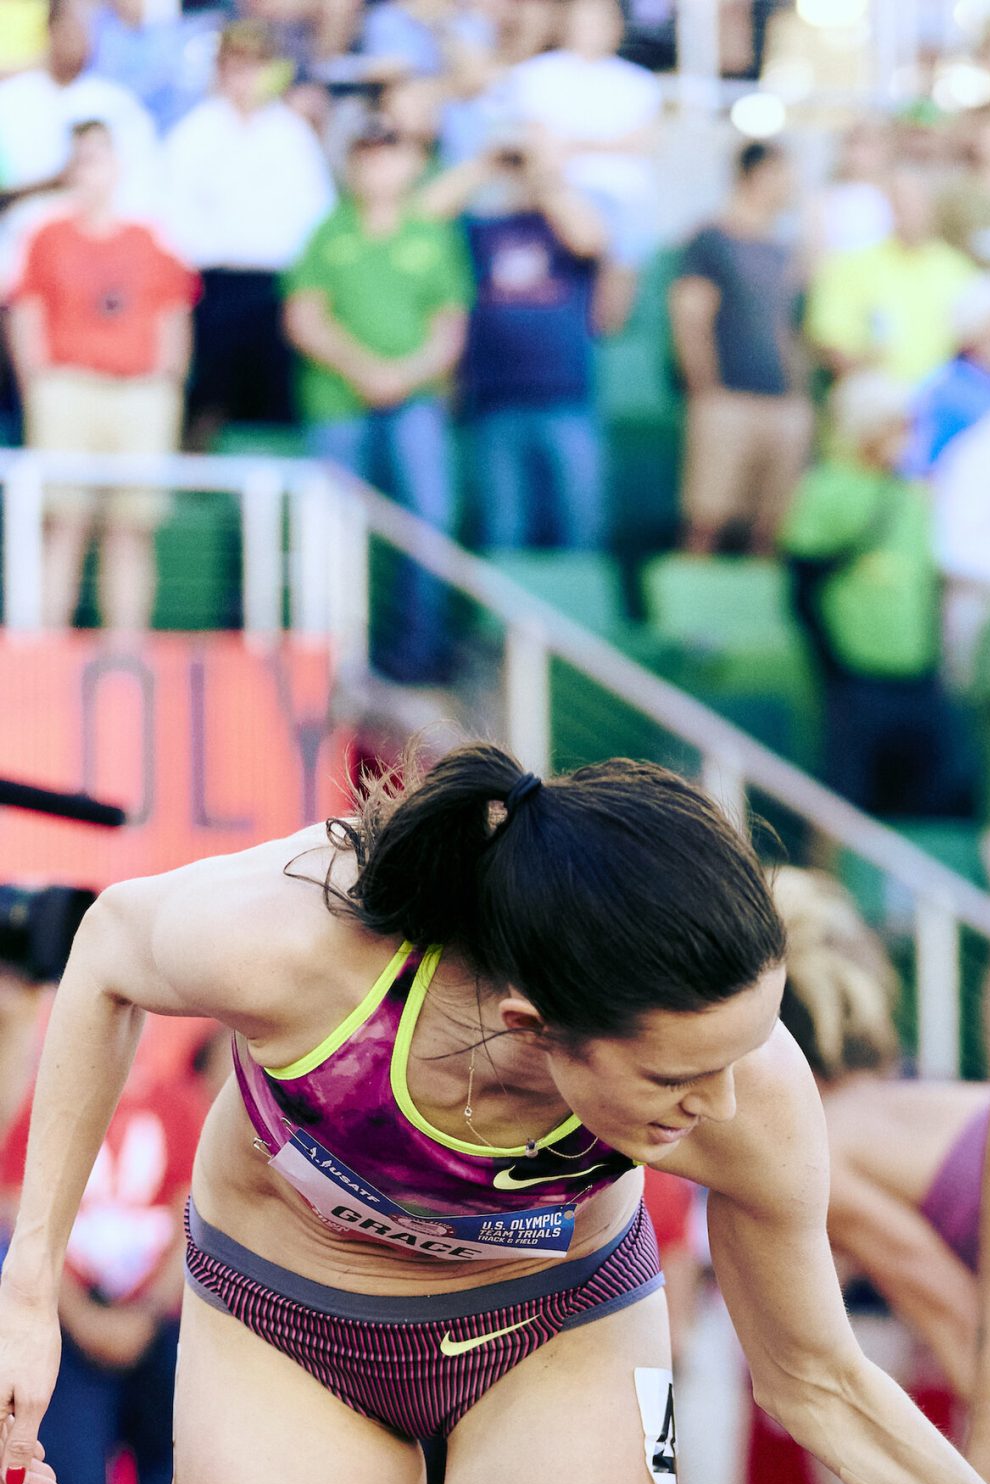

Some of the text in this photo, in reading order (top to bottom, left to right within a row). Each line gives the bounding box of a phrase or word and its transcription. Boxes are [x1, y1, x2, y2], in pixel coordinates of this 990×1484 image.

[329, 1166, 381, 1203] USATF
[481, 1212, 562, 1230] U.S. OLYMPIC
[331, 1205, 483, 1259] GRACE
[477, 1235, 506, 1244] TRACK
[479, 1227, 562, 1239] TEAM TRIALS
